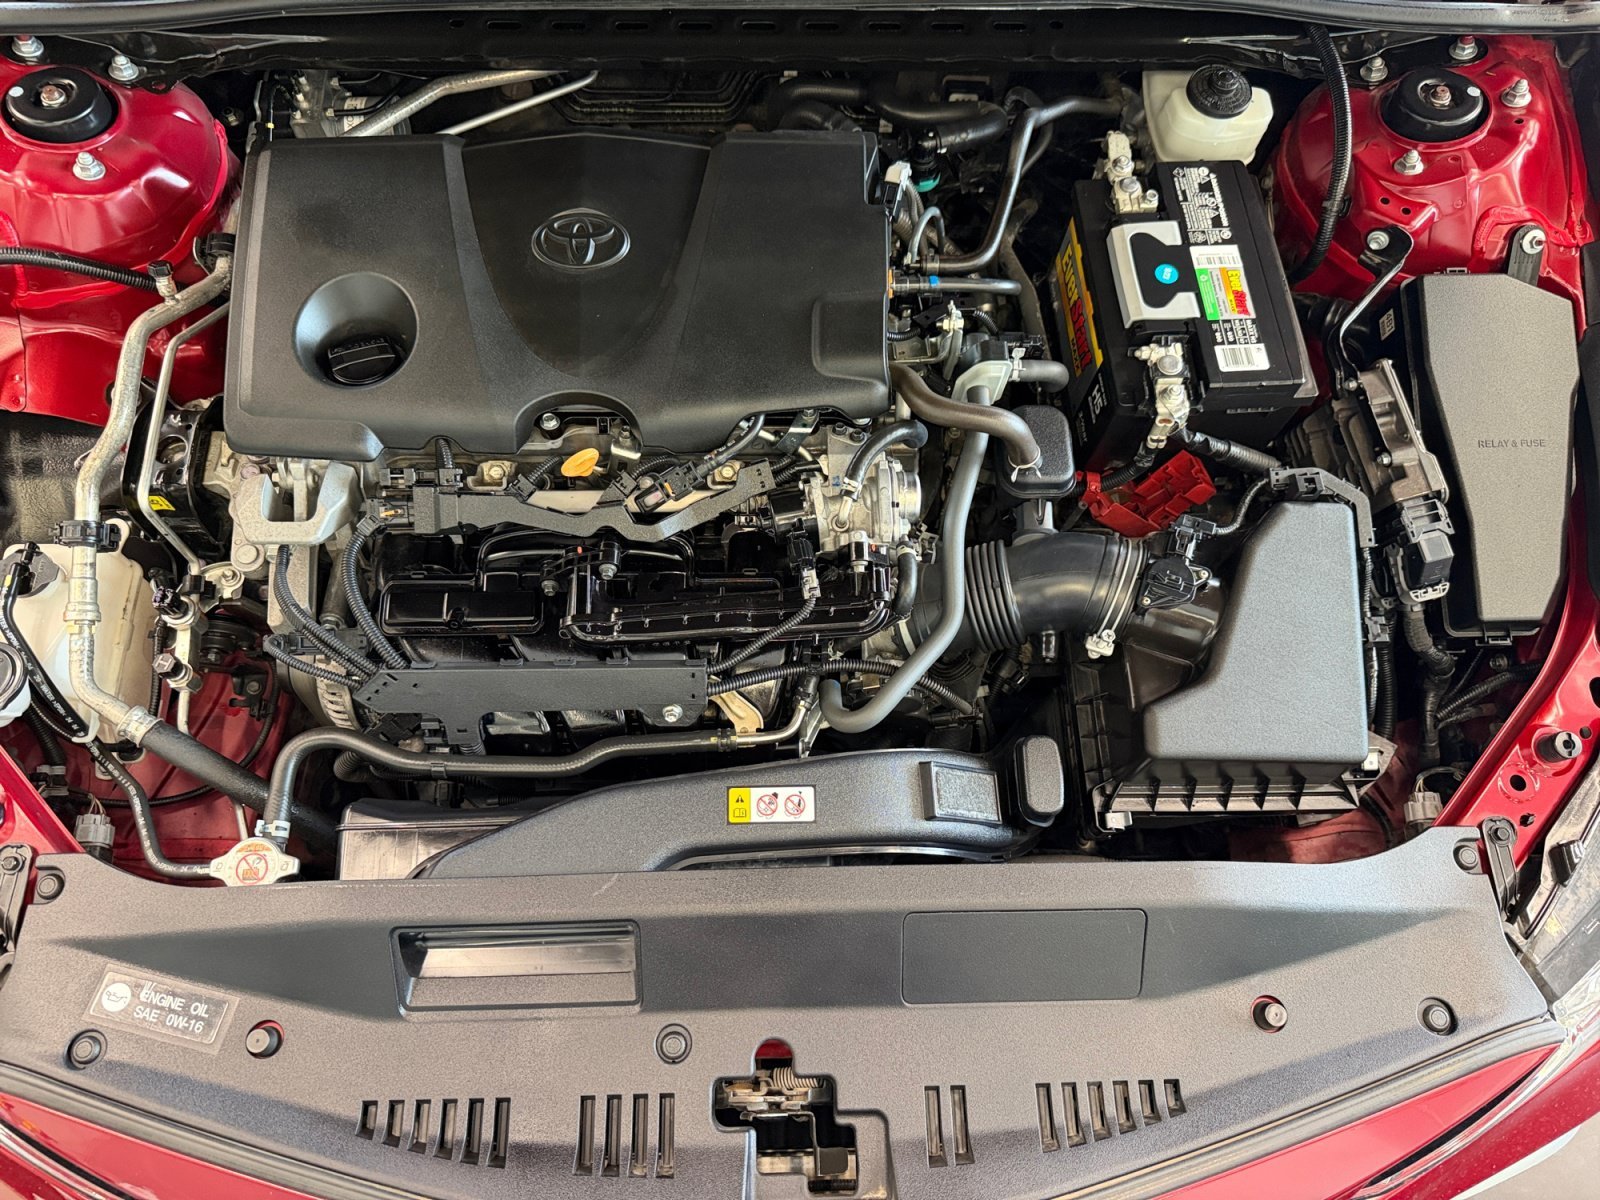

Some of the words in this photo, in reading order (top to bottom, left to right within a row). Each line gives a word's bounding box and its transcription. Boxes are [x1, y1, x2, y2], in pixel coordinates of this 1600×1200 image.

[1062, 244, 1092, 369] EverStart
[1227, 269, 1251, 317] EverStart
[1478, 439, 1510, 448] RELAY
[1511, 439, 1518, 448] &
[1520, 439, 1547, 448] FUSE
[155, 655, 173, 670] H
[41, 682, 55, 702] WATER
[140, 989, 186, 1011] ENGINE
[190, 1002, 210, 1018] OIL
[133, 1005, 160, 1022] SAE
[165, 1013, 205, 1034] 0W-16
